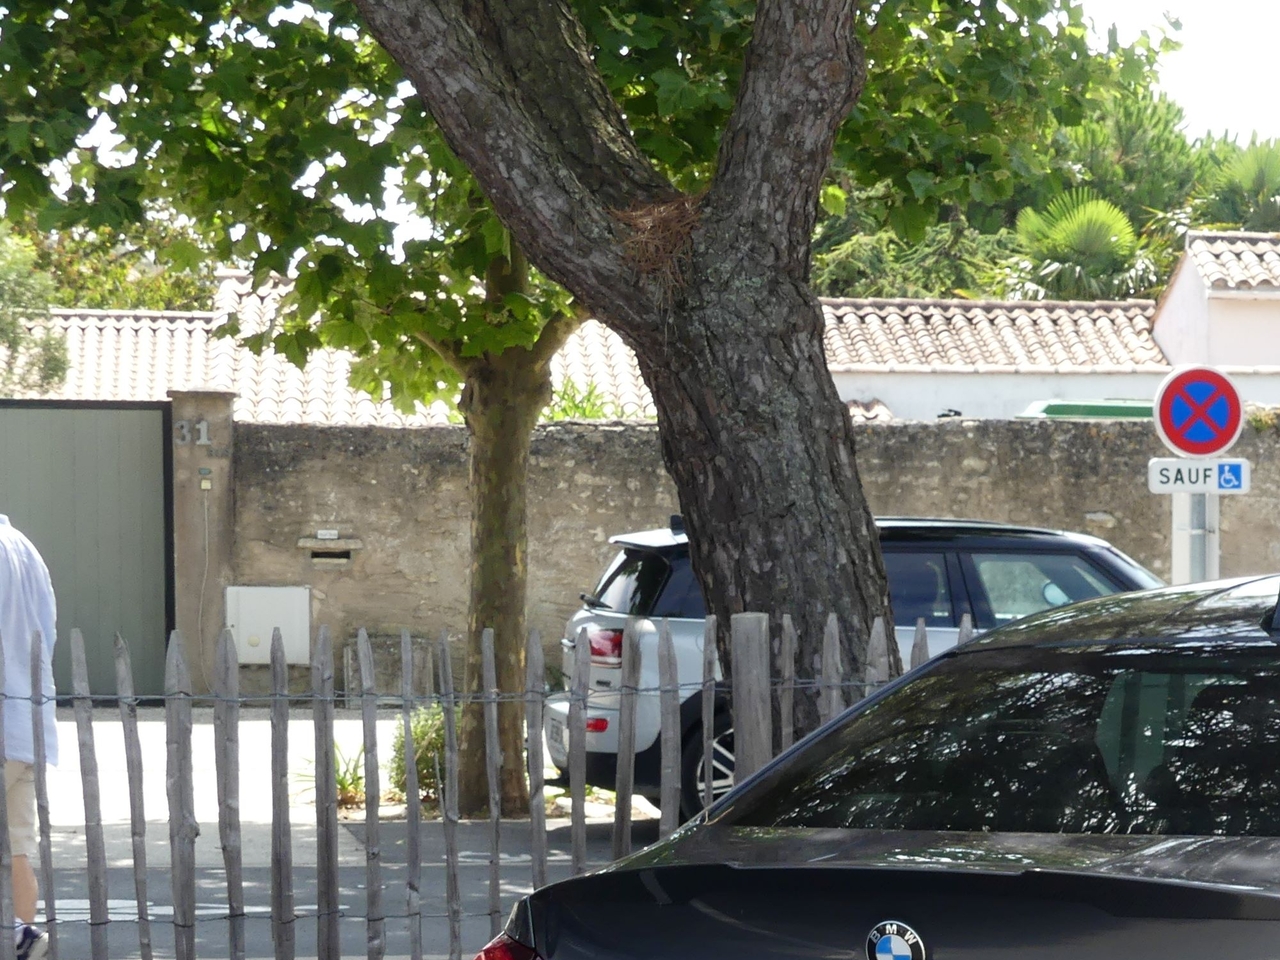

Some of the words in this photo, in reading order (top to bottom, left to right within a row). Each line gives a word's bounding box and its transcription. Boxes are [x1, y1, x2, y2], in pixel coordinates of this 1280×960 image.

[173, 420, 211, 445] 31
[1159, 467, 1213, 485] SAUF
[870, 923, 918, 944] BMW
